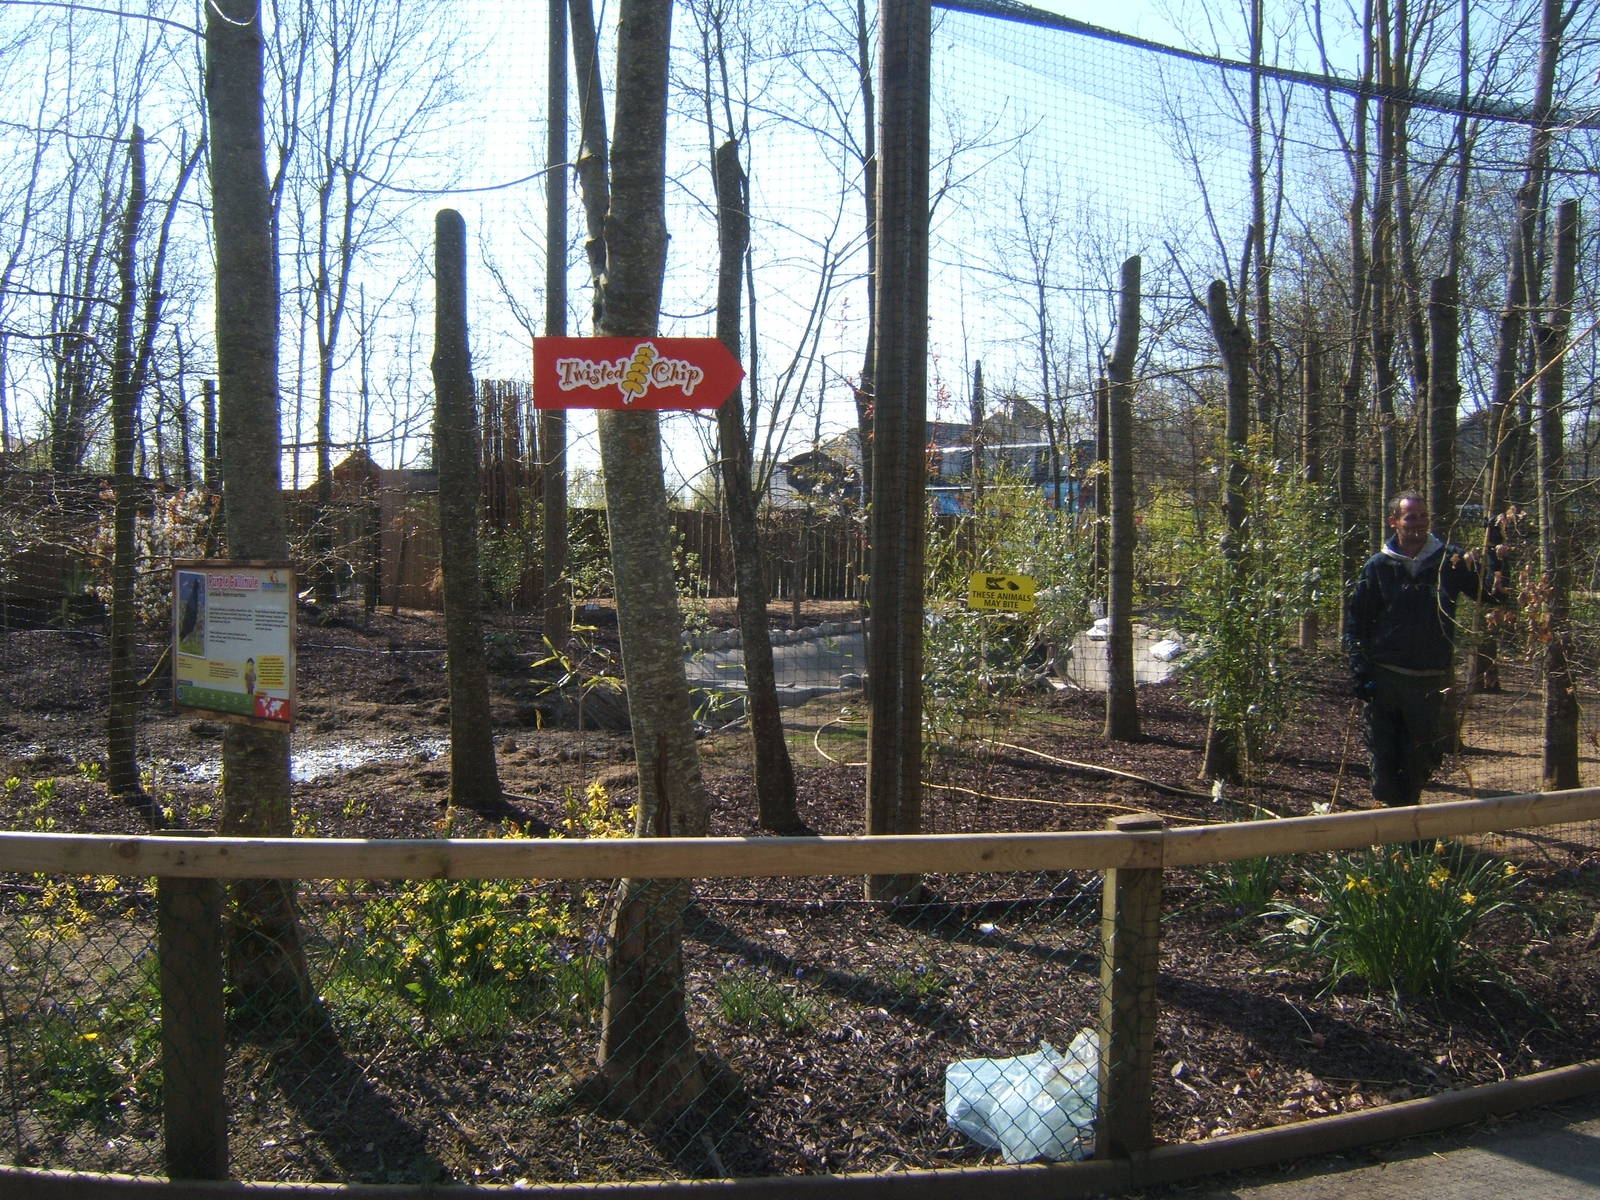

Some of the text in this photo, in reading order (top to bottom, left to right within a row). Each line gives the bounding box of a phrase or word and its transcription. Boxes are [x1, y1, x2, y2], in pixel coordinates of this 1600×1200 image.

[560, 360, 699, 390] Twisted Chip
[972, 591, 1031, 602] THESE ANIMALS
